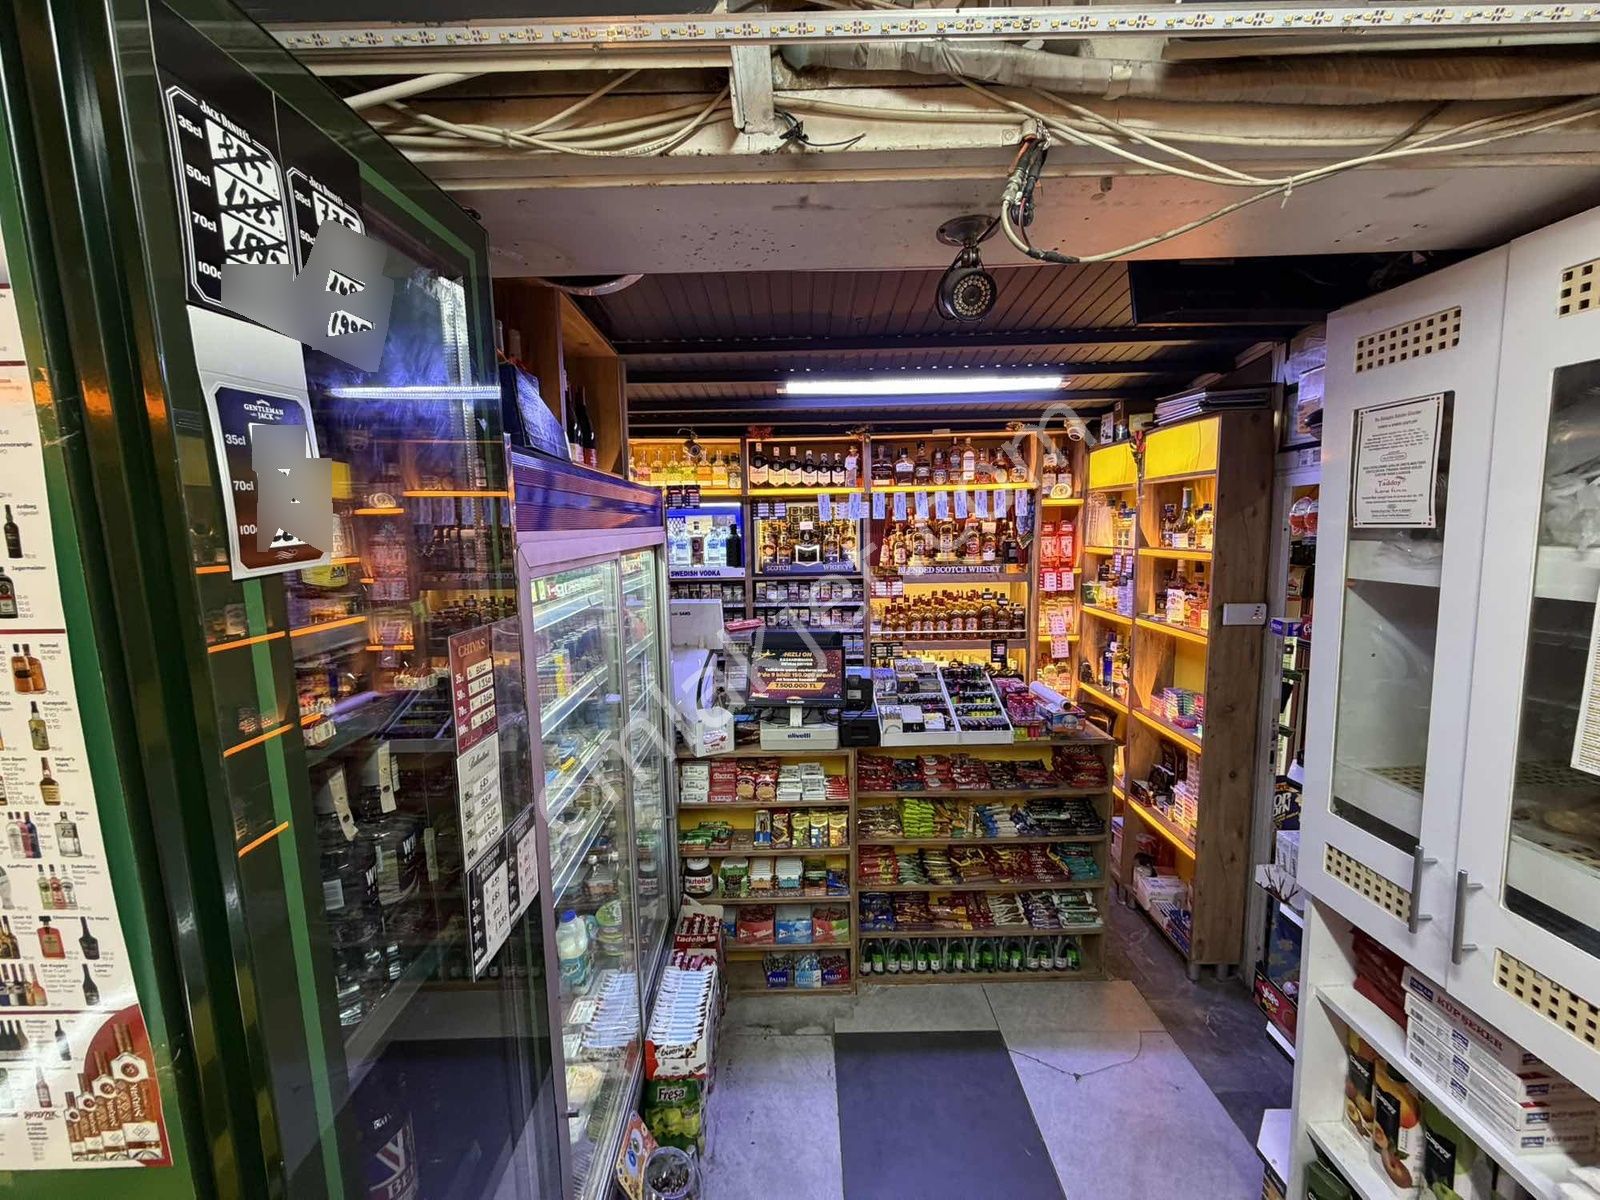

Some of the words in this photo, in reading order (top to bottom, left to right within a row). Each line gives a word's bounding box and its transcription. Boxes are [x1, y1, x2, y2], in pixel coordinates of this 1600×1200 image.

[177, 114, 203, 139] 35cl
[186, 164, 212, 188] 50cl
[192, 211, 218, 233] 70cl
[198, 260, 222, 280] 100c
[244, 403, 284, 416] GENTLEMAN
[225, 434, 246, 446] 35cl
[234, 480, 254, 491] 70cl
[936, 566, 968, 574] SCOTCH
[968, 566, 1001, 574] WHISKY
[458, 638, 486, 658] CHIVAS
